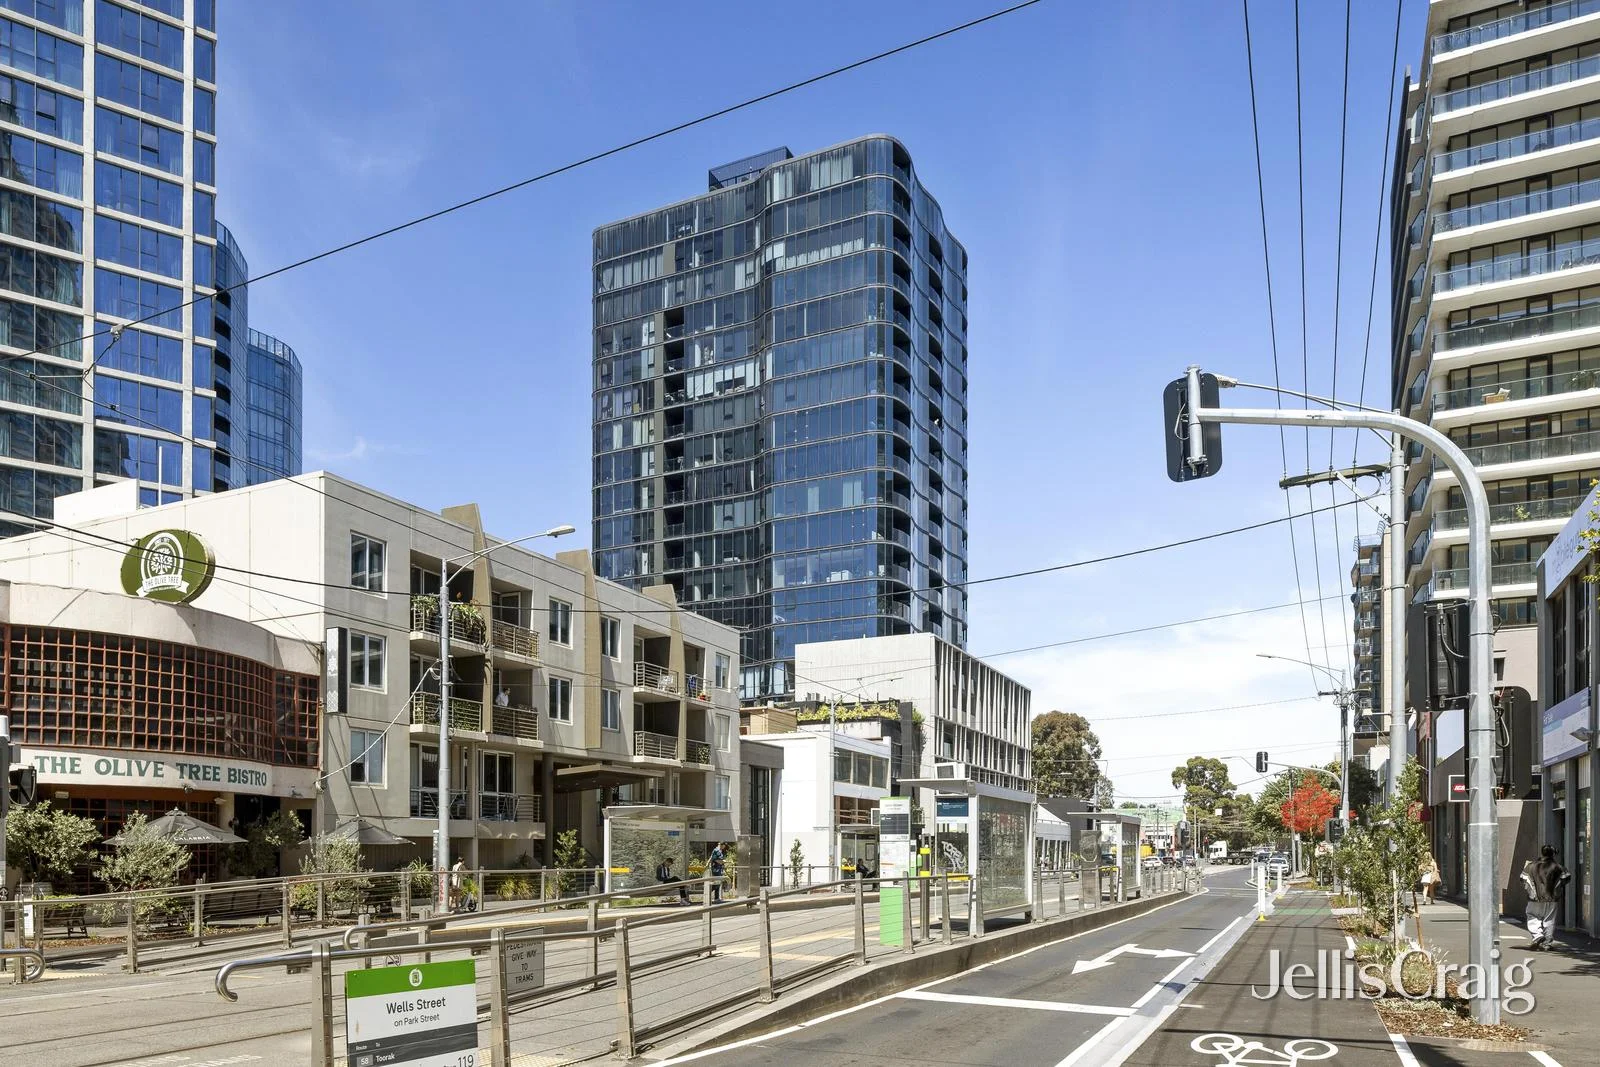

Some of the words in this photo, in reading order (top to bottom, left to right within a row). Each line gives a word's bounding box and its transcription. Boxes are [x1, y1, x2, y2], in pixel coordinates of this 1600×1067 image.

[154, 576, 167, 586] OLIVE
[167, 575, 180, 584] TREE
[34, 755, 82, 774] THE
[94, 757, 165, 779] OLIVE
[175, 762, 221, 782] TREE
[227, 767, 267, 786] BISTRO
[511, 951, 524, 962] GIVE
[521, 962, 529, 971] TO
[515, 972, 534, 984] TRAMS
[386, 1000, 414, 1015] Wells
[416, 996, 446, 1011] Street
[394, 1019, 403, 1027] on
[404, 1016, 419, 1026] Park
[420, 1013, 440, 1023] Street
[360, 1057, 369, 1065] 58
[375, 1052, 395, 1063] Toorak
[457, 1054, 474, 1067] 119
